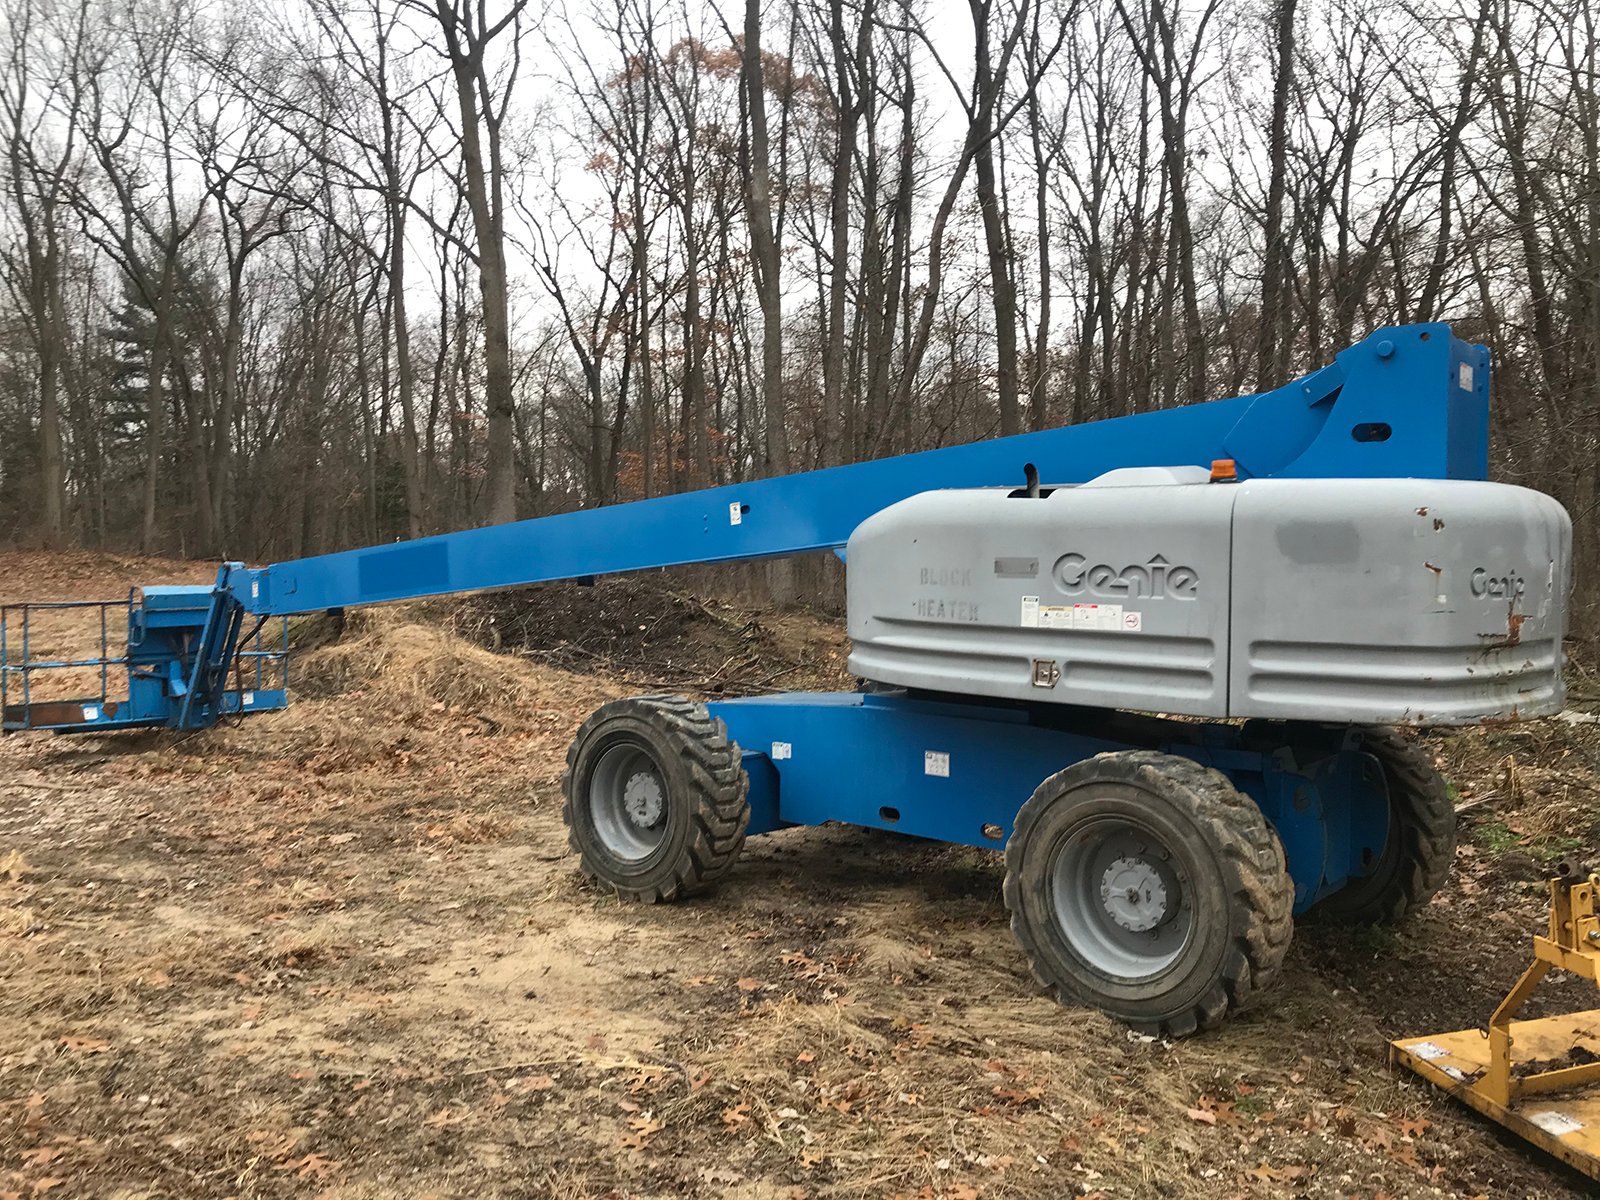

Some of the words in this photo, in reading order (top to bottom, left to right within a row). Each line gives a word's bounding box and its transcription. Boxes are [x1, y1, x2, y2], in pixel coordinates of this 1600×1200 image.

[920, 567, 972, 587] BLOCK
[1052, 552, 1200, 600] Genie
[1470, 567, 1525, 600] Genie
[918, 599, 978, 621] HEATER
